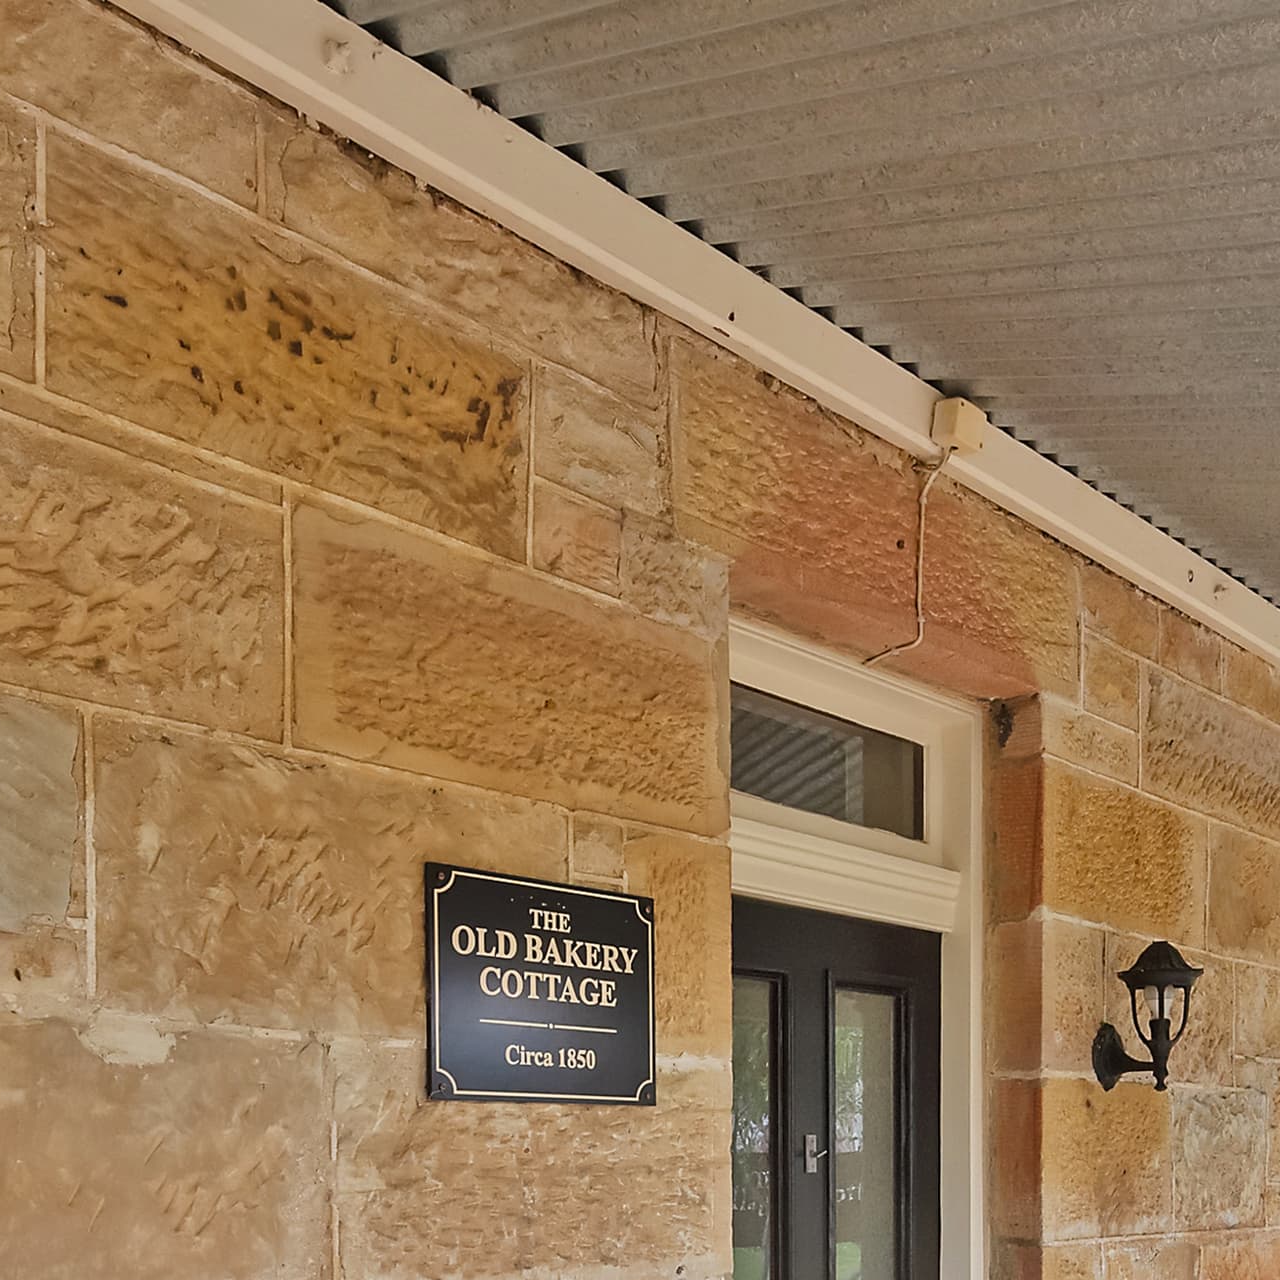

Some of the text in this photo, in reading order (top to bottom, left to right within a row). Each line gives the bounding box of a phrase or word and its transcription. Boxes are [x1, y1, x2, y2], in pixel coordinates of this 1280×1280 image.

[528, 908, 571, 933] THE
[451, 924, 638, 974] OLD BAKERY
[479, 966, 617, 1007] COTTAGE
[505, 1044, 596, 1070] Circa 1850
